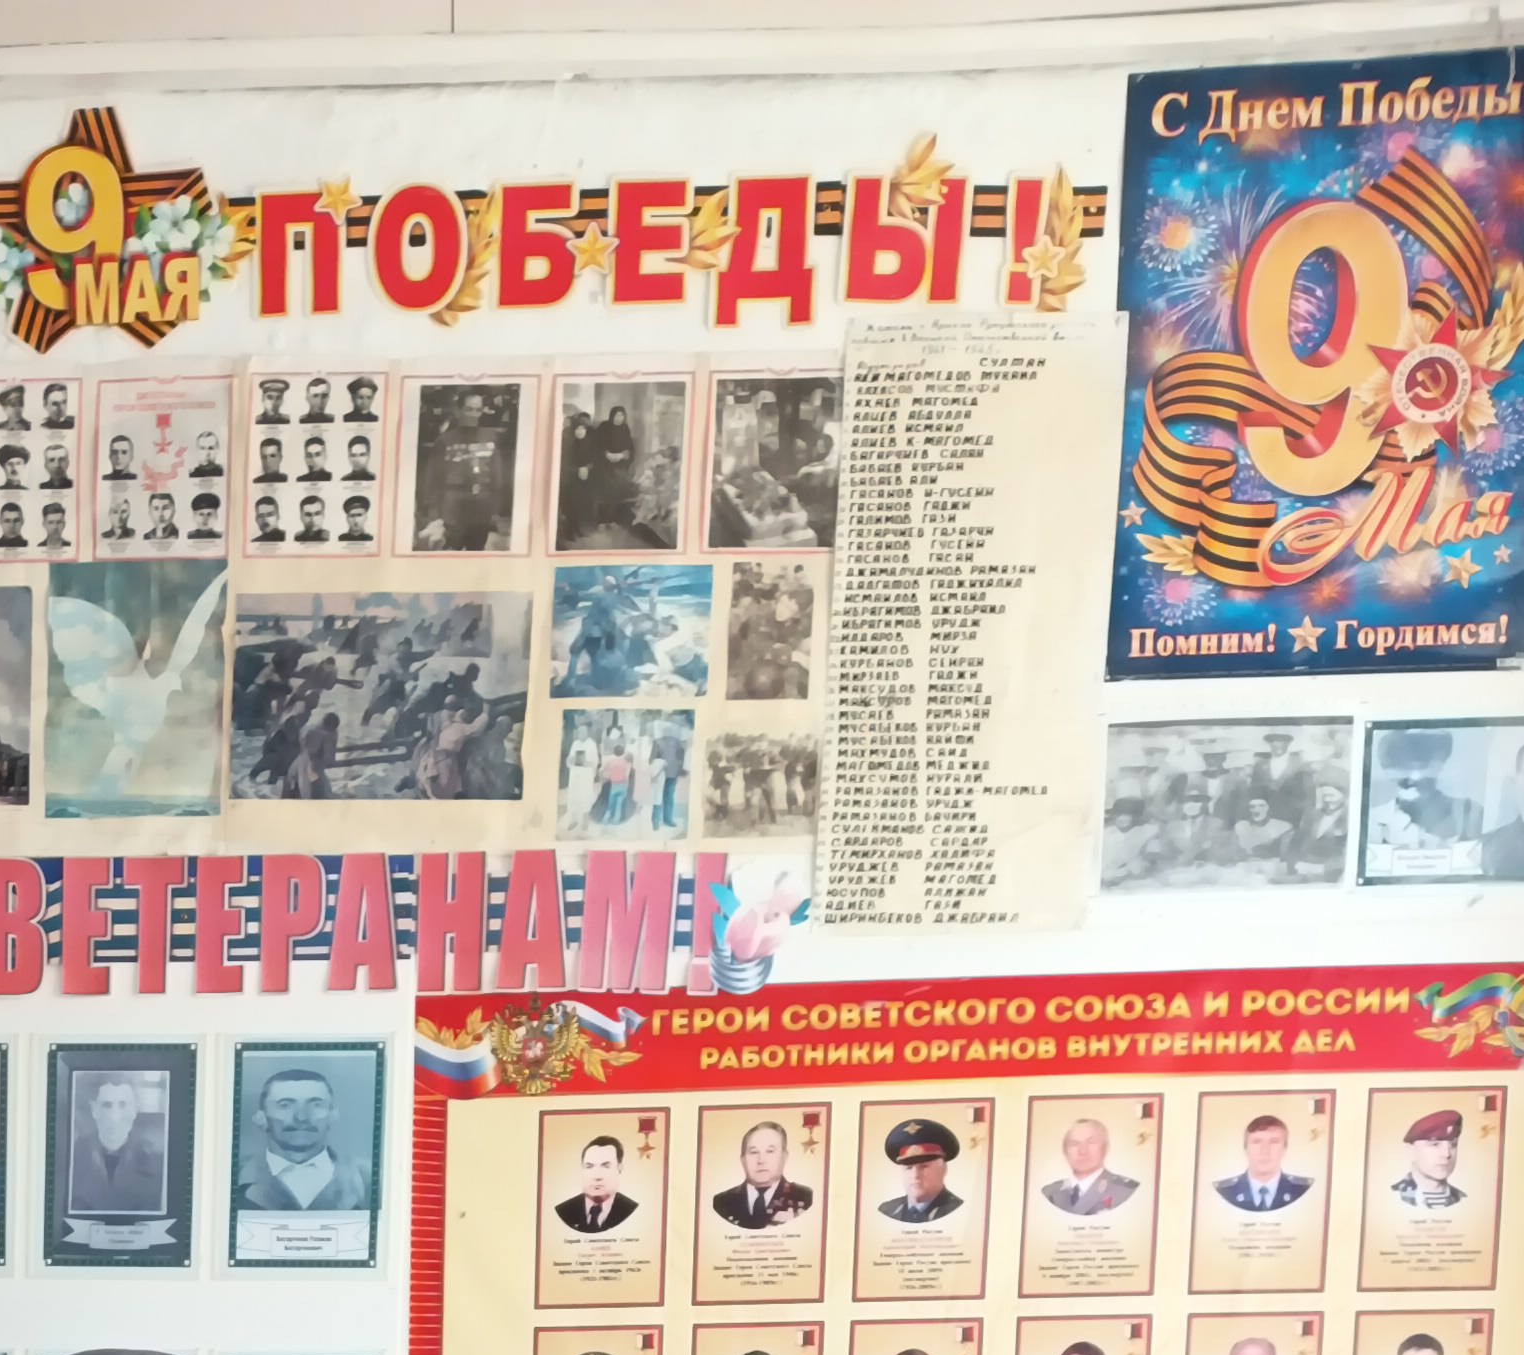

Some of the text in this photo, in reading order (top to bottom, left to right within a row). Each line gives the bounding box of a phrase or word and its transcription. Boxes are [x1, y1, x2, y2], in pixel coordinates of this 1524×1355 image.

[1152, 77, 1524, 145] С Днем Победы
[22, 145, 126, 310] 9
[259, 175, 1044, 328] ПОБЕДЫ!
[75, 252, 202, 327] МАЯ
[1236, 200, 1409, 498] 9
[911, 396, 979, 407] МАГОМЕД
[851, 424, 896, 434] АЛИЕВ
[850, 437, 897, 448] АЛИЕВ
[849, 463, 902, 474] БАБАЕВ
[850, 475, 939, 488] БАБАЕВ АЛИ
[850, 488, 914, 499] ГАСАНОВ
[849, 502, 912, 513] ГАСАНОВ
[1257, 466, 1514, 587] Мая
[848, 540, 911, 551] ГАСАНОВ
[847, 553, 910, 564] ГАСАНОВ
[970, 565, 1037, 576] РАМАЗАН
[929, 591, 987, 602] ИСМАИЛ
[843, 605, 922, 617] ИБРАГИМОВ
[842, 618, 922, 630] ИБРАГИМОВ
[1129, 615, 1510, 659] Помним! Гордимся!
[839, 657, 914, 669] КУРБАНОВ
[927, 695, 993, 706] МАГОМЕД
[926, 708, 991, 720] РАМАЗАН
[835, 786, 919, 796] РАМАЗАНОВ
[834, 798, 919, 809] РАМАЗАНОВ
[832, 811, 917, 822] РАМАЗАНОВ
[830, 836, 988, 848] САРДАРОВ САРДАР
[924, 862, 995, 872] РАМАЗАН
[923, 873, 997, 885] МАГОМЕД
[826, 887, 886, 899] ЮСУПОВ
[824, 912, 923, 925] ШИРИНБЕКОВ
[651, 987, 1412, 1036] ГЕРОИ СОВЕТСКОГО СОЮЗА И РОССИИ
[700, 1029, 1356, 1070] РАБОТНИКИ ОРГАНОВ ВНУТРЕННИХ ДЕЛ
